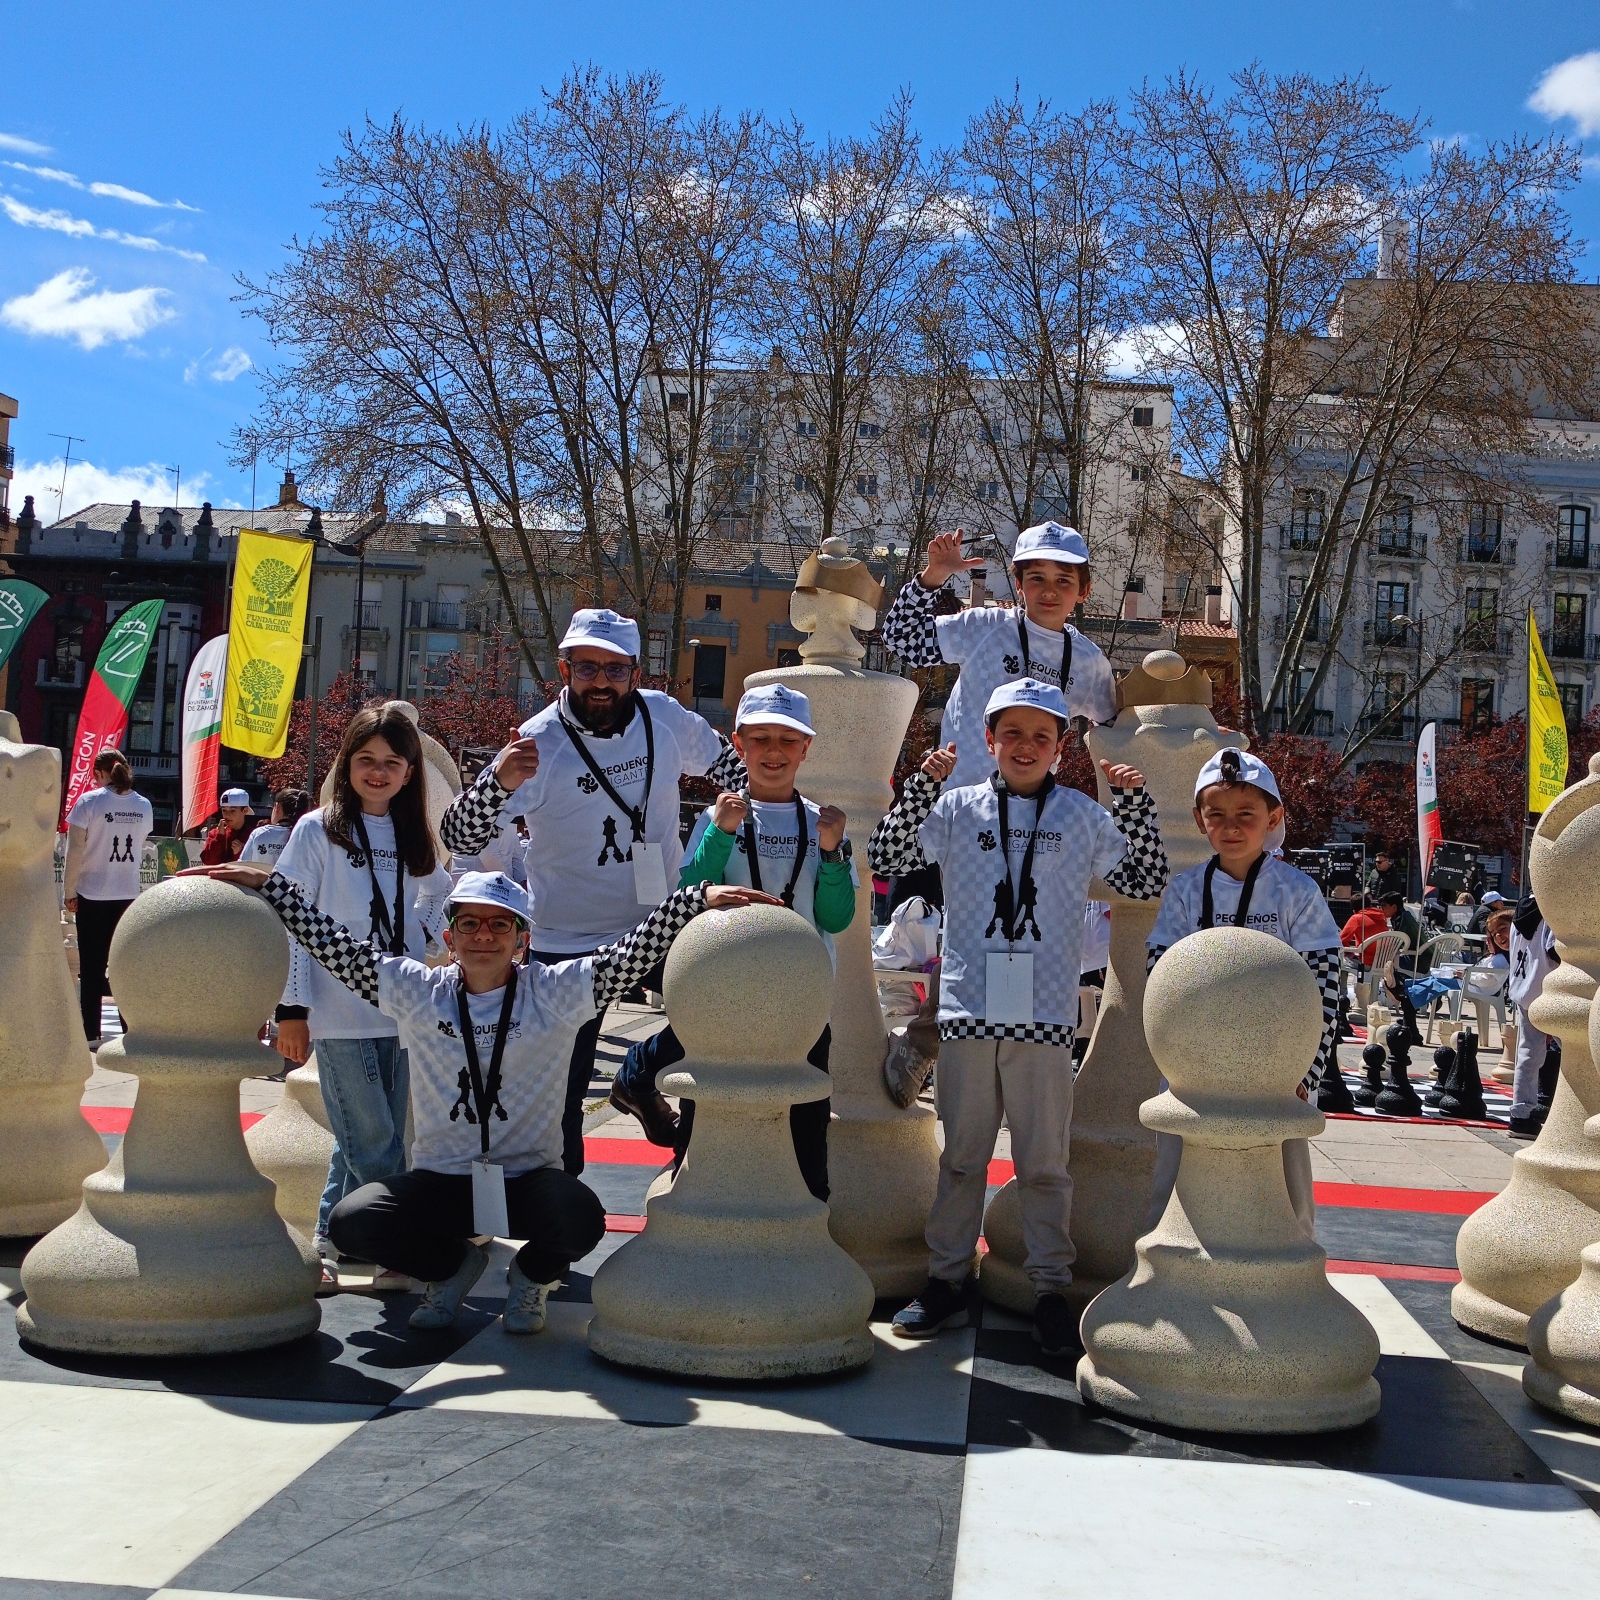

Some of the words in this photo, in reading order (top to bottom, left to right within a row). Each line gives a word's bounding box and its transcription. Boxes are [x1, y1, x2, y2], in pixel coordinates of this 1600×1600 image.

[246, 614, 291, 626] FUNDACION
[265, 624, 291, 633] RURAL
[600, 756, 650, 776] PEQUEÑO
[1007, 829, 1062, 841] EQUEÑOS
[1215, 913, 1278, 924] PEQEÑOS
